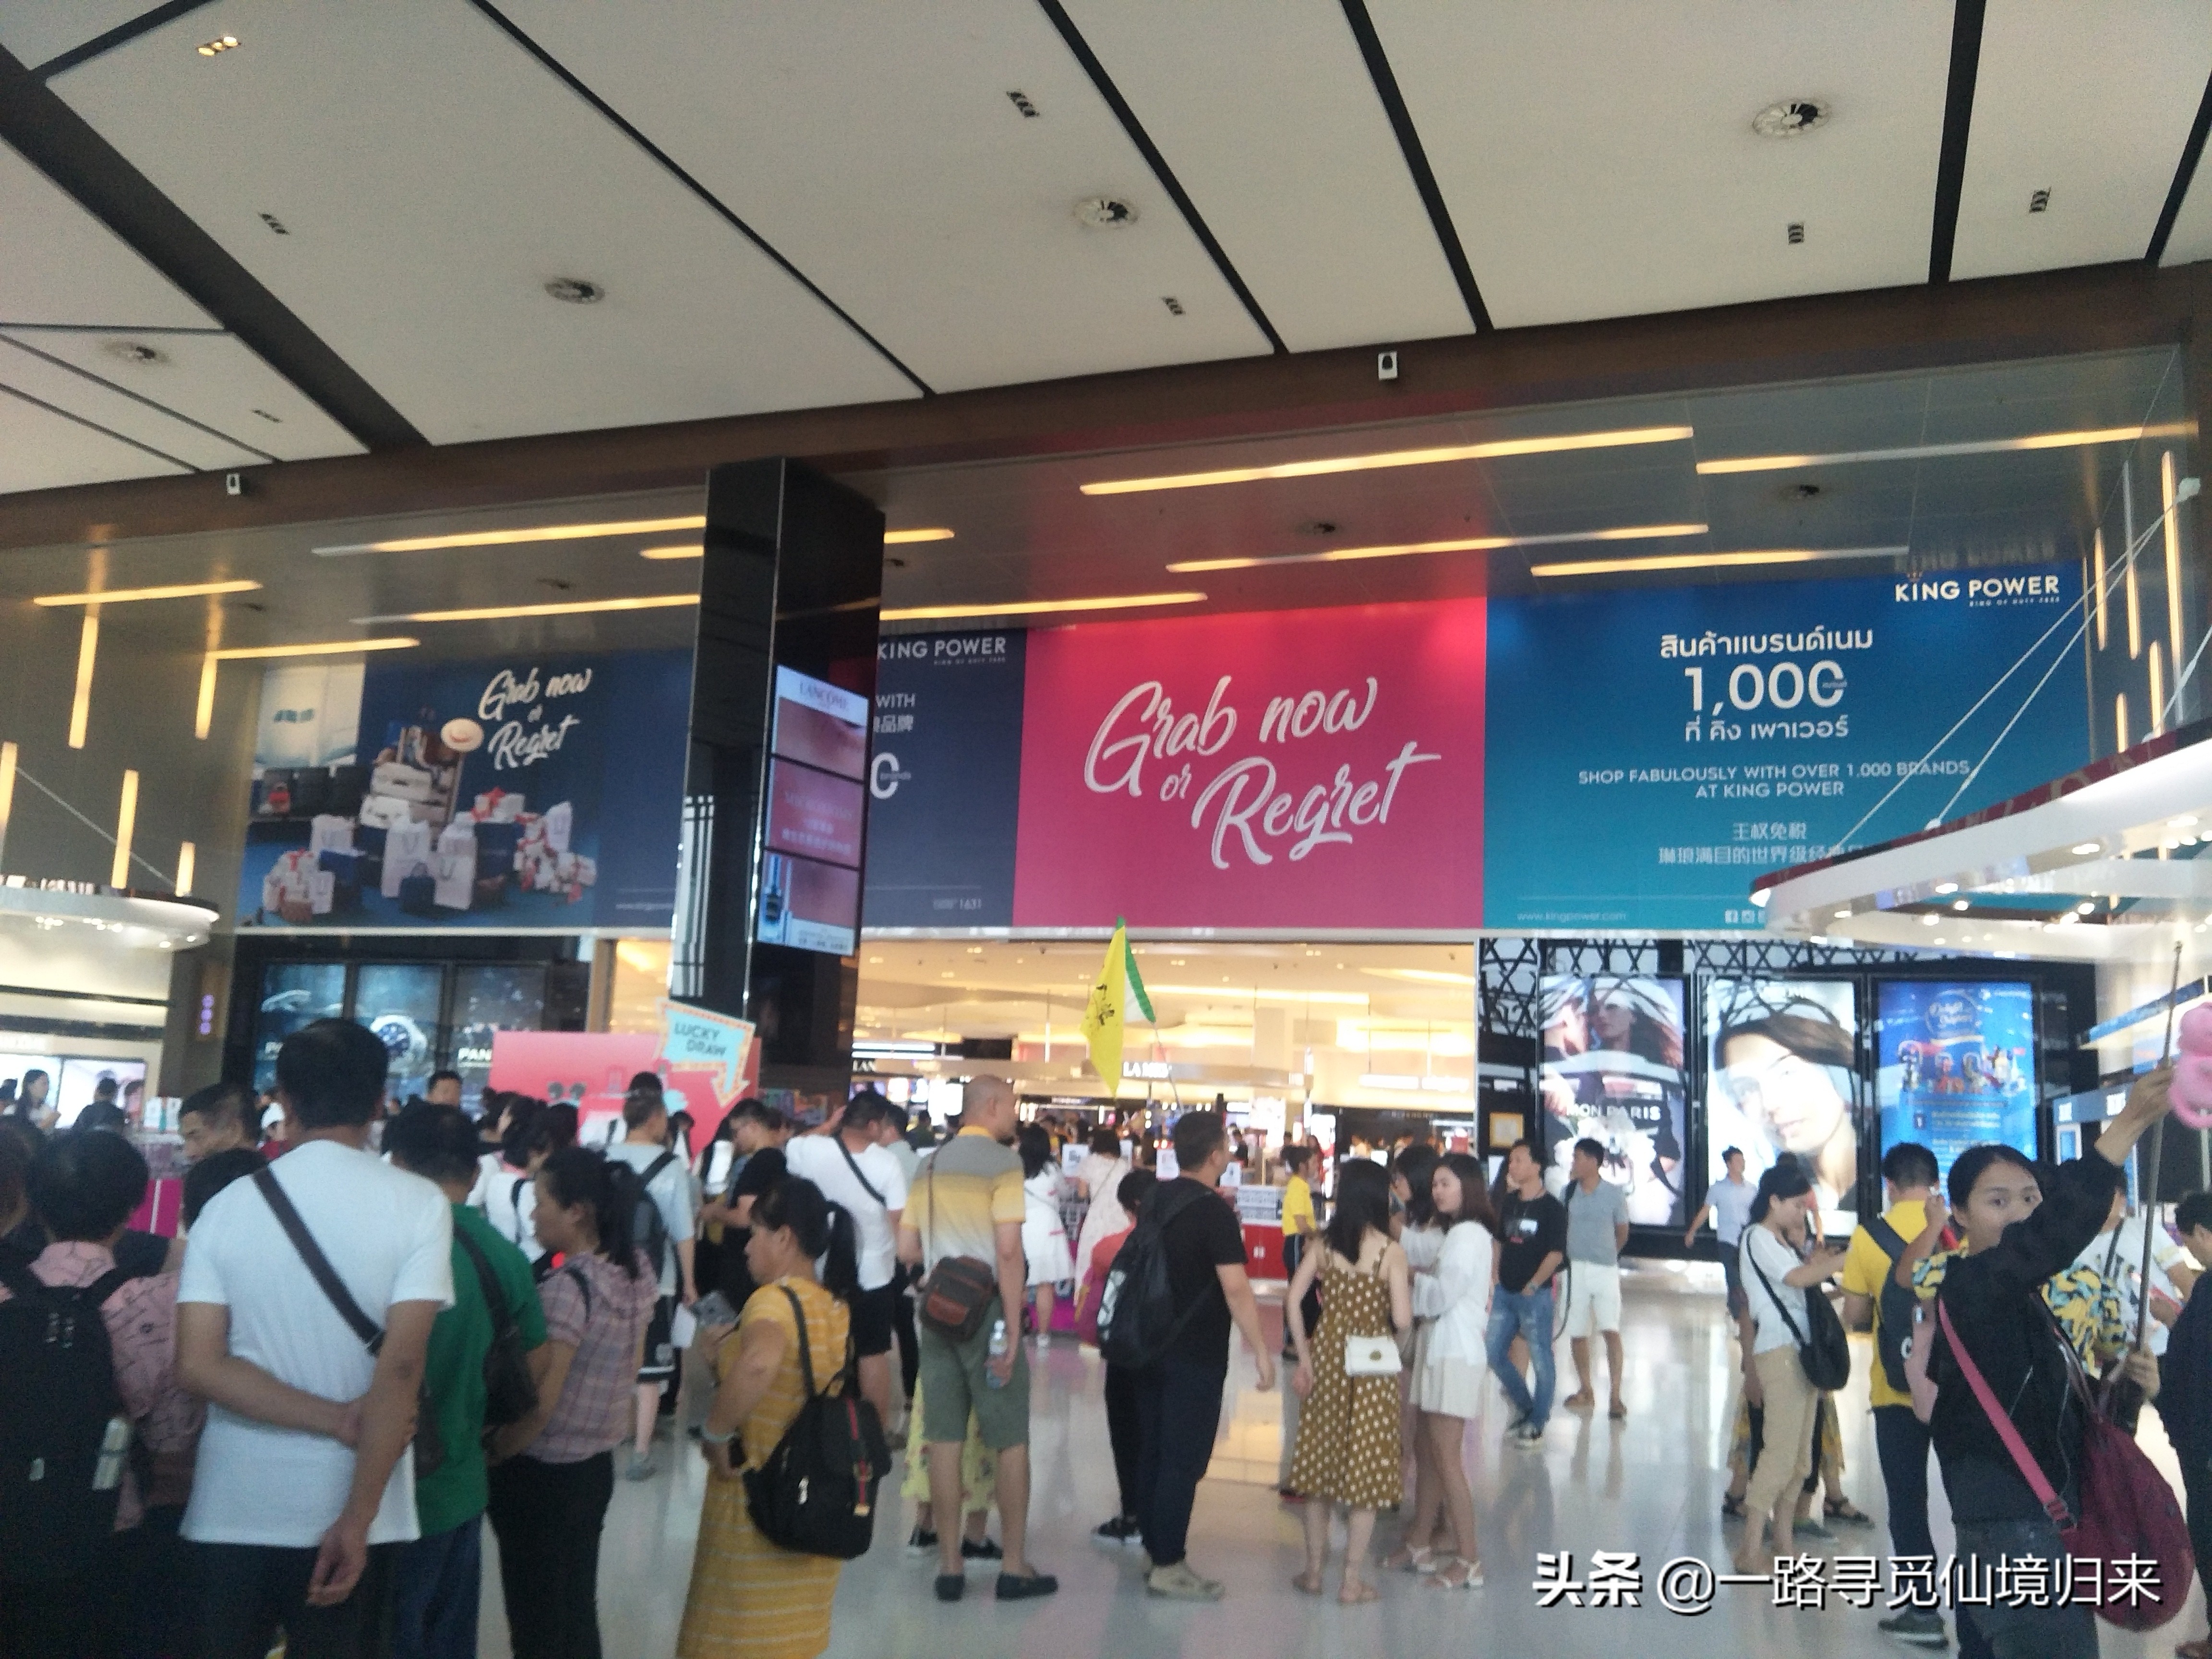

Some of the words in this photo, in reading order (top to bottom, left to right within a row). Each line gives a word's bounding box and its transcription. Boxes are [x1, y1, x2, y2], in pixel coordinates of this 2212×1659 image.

[1895, 580, 1960, 602] KING
[1968, 575, 2059, 599] POWER
[877, 640, 928, 660] KING
[934, 636, 1006, 657] POWER
[1660, 625, 1872, 658] สินค้าแบรนด์เนม
[478, 667, 540, 721] Grab
[545, 668, 593, 697] now
[875, 693, 915, 708] WITH
[1083, 675, 1238, 797] Grab
[1259, 675, 1378, 744] now
[1750, 714, 1849, 740] เพาเวอร์
[487, 714, 580, 771] Regret
[1160, 764, 1191, 801] or
[1578, 770, 1624, 785] SHOP
[1630, 766, 1737, 782] FABULOUSLY
[1743, 765, 1786, 780] WITH
[1791, 764, 1840, 779] OVER
[1896, 760, 1969, 776] BRANDS
[1695, 783, 1719, 799] AT
[1723, 782, 1771, 798] KING
[1776, 781, 1844, 797] POWER
[1190, 741, 1442, 870] Regret
[674, 1022, 721, 1041] LUCKY
[686, 1039, 726, 1056] DRAW
